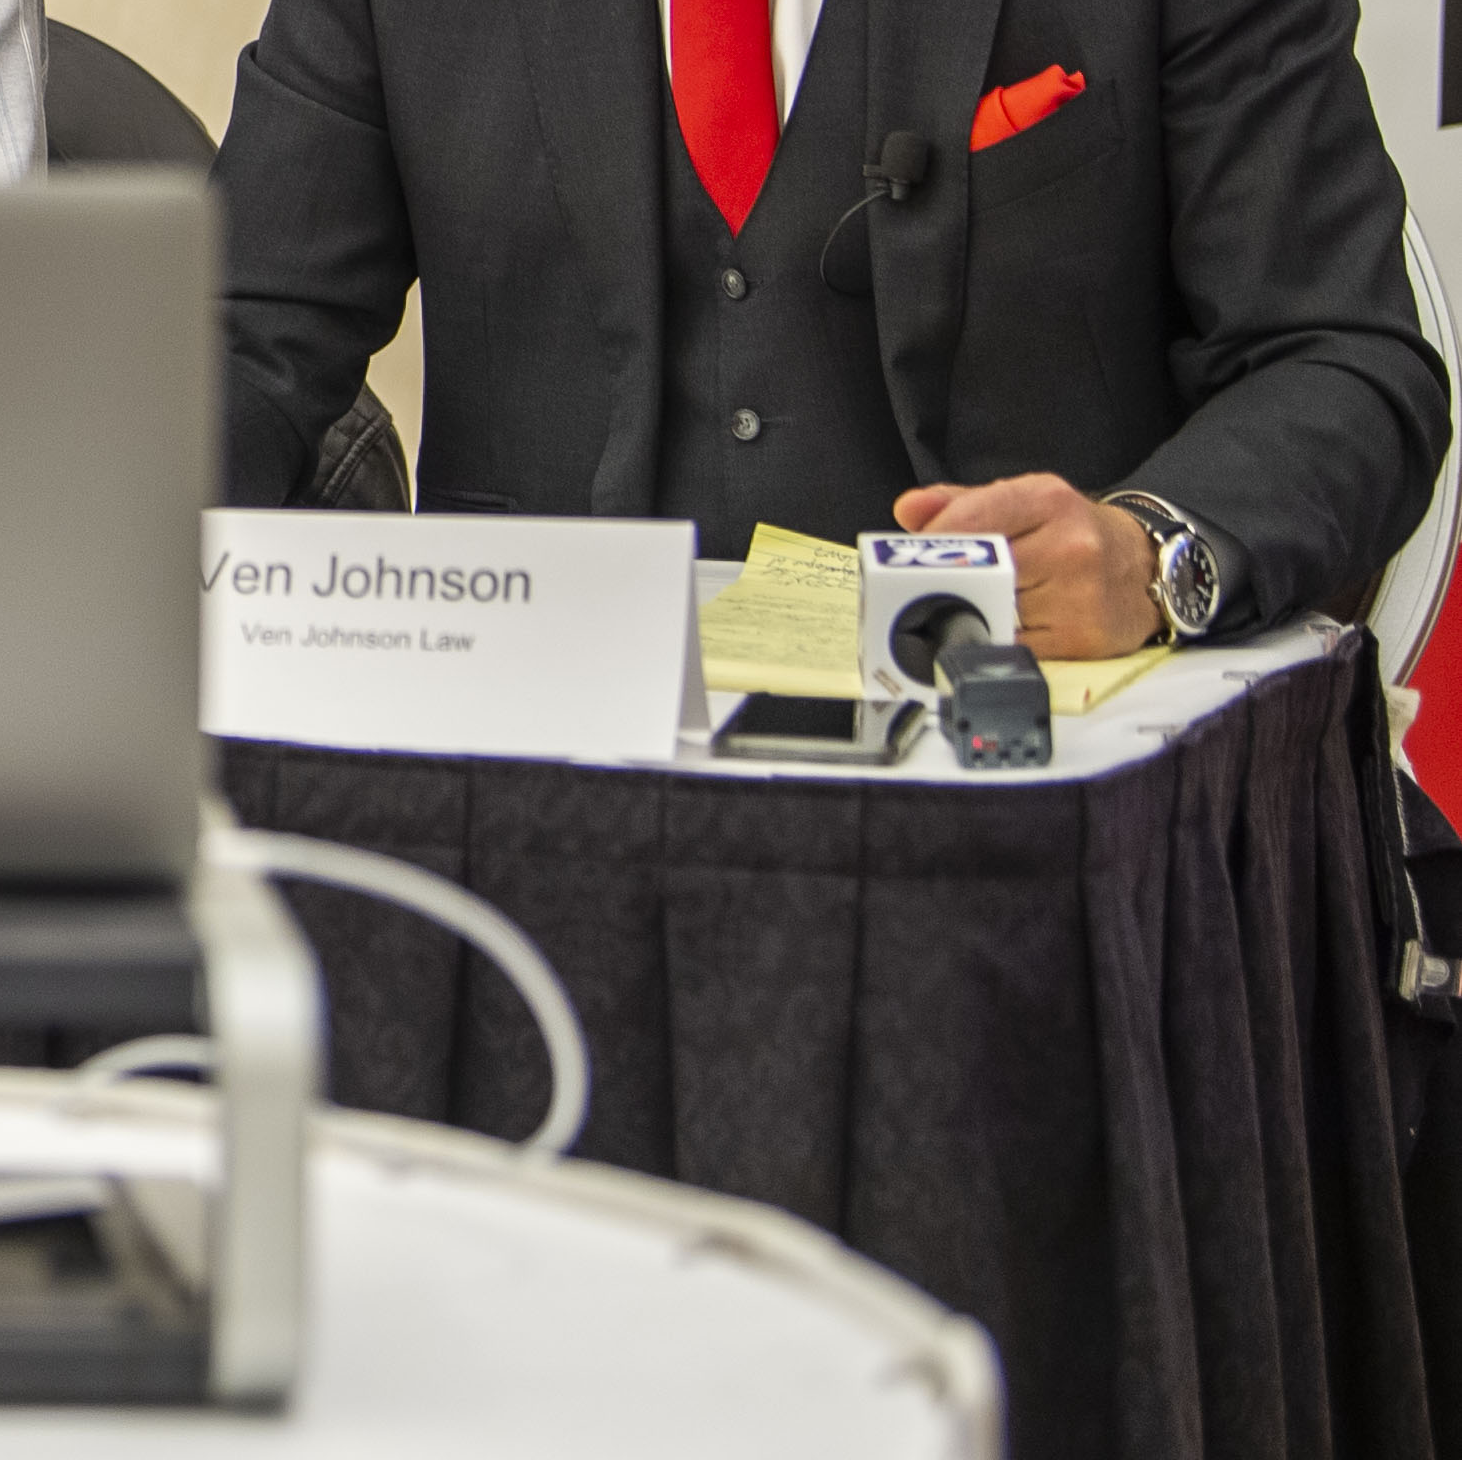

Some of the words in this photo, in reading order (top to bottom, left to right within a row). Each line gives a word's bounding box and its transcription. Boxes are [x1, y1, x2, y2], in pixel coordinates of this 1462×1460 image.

[199, 551, 292, 596] Ven
[311, 552, 532, 604] Johnson
[240, 623, 293, 647] Ven
[299, 624, 412, 650] Johnson
[419, 628, 475, 653] Law
